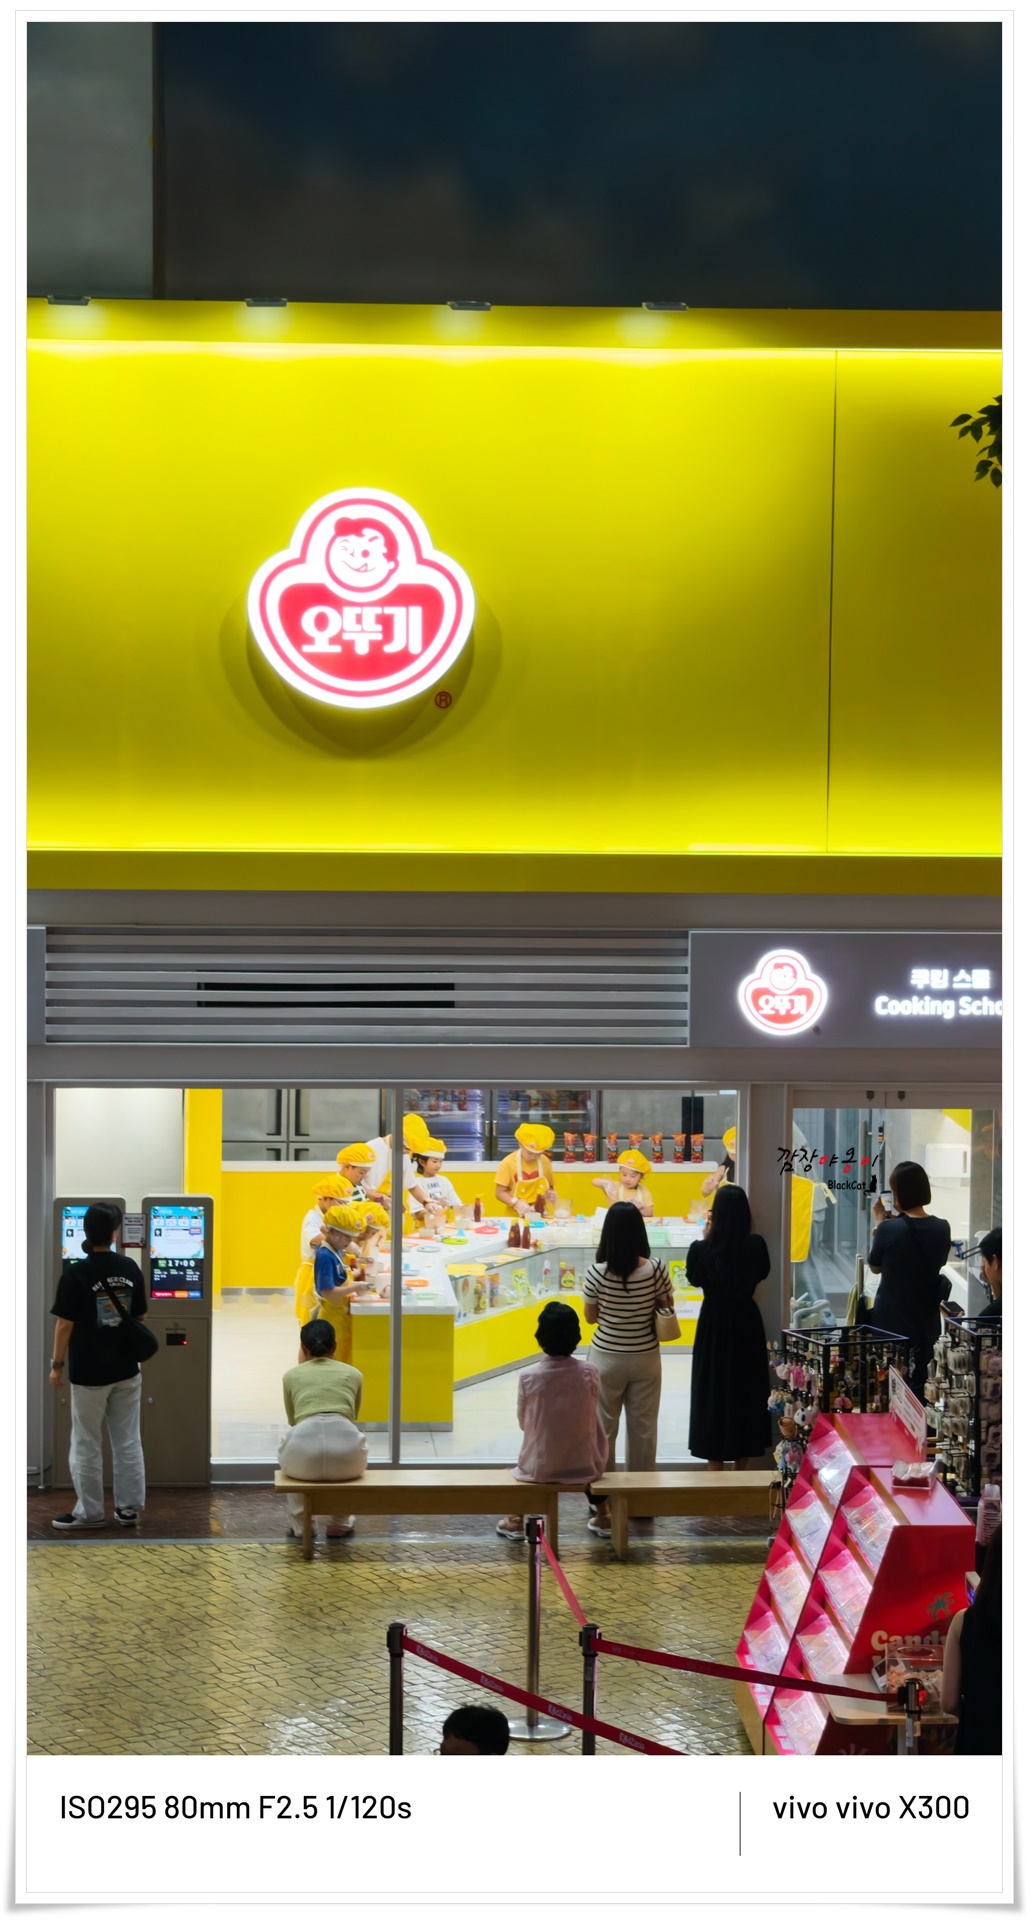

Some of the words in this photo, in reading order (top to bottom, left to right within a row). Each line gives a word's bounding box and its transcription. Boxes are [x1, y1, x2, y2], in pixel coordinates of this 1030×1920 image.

[300, 604, 423, 656] 오뚜기
[910, 968, 949, 990] 쿠킹
[758, 994, 807, 1016] 오뚜기
[874, 995, 956, 1020] Cooking
